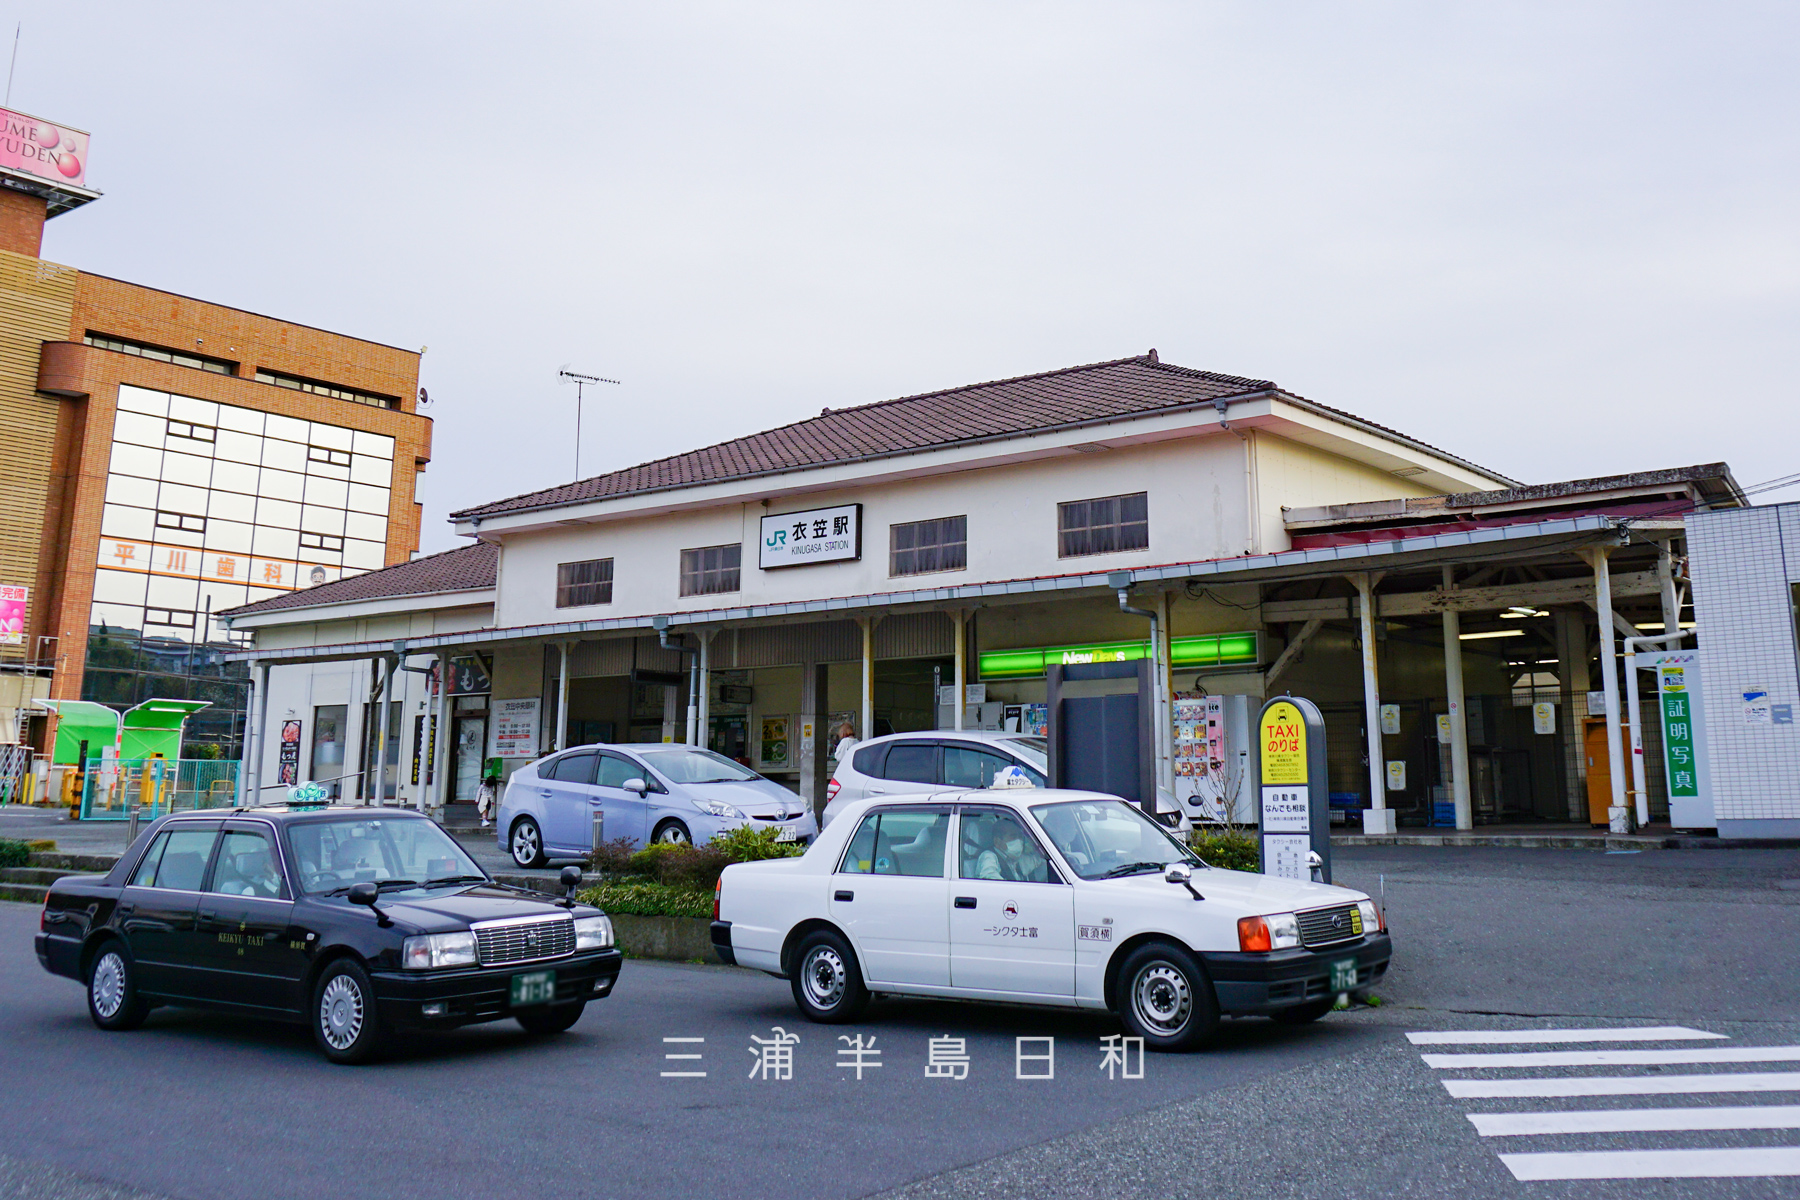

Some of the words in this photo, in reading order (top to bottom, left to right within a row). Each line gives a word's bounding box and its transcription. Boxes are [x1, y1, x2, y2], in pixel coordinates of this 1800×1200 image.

[792, 515, 848, 541] 衣笠駅
[766, 530, 787, 547] JR
[791, 543, 822, 555] KINUGASA
[824, 540, 849, 552] STATION
[114, 543, 282, 584] 平川歯科
[0, 586, 26, 600] 完備
[1062, 649, 1126, 665] NewDays
[1267, 724, 1299, 738] TAXI
[1268, 739, 1299, 752] のりば
[1668, 700, 1693, 789] 証明写真
[1272, 793, 1298, 802] 自動車
[1265, 804, 1306, 813] なんでも相談
[218, 932, 244, 945] KEIKYU
[247, 935, 264, 947] TAXI
